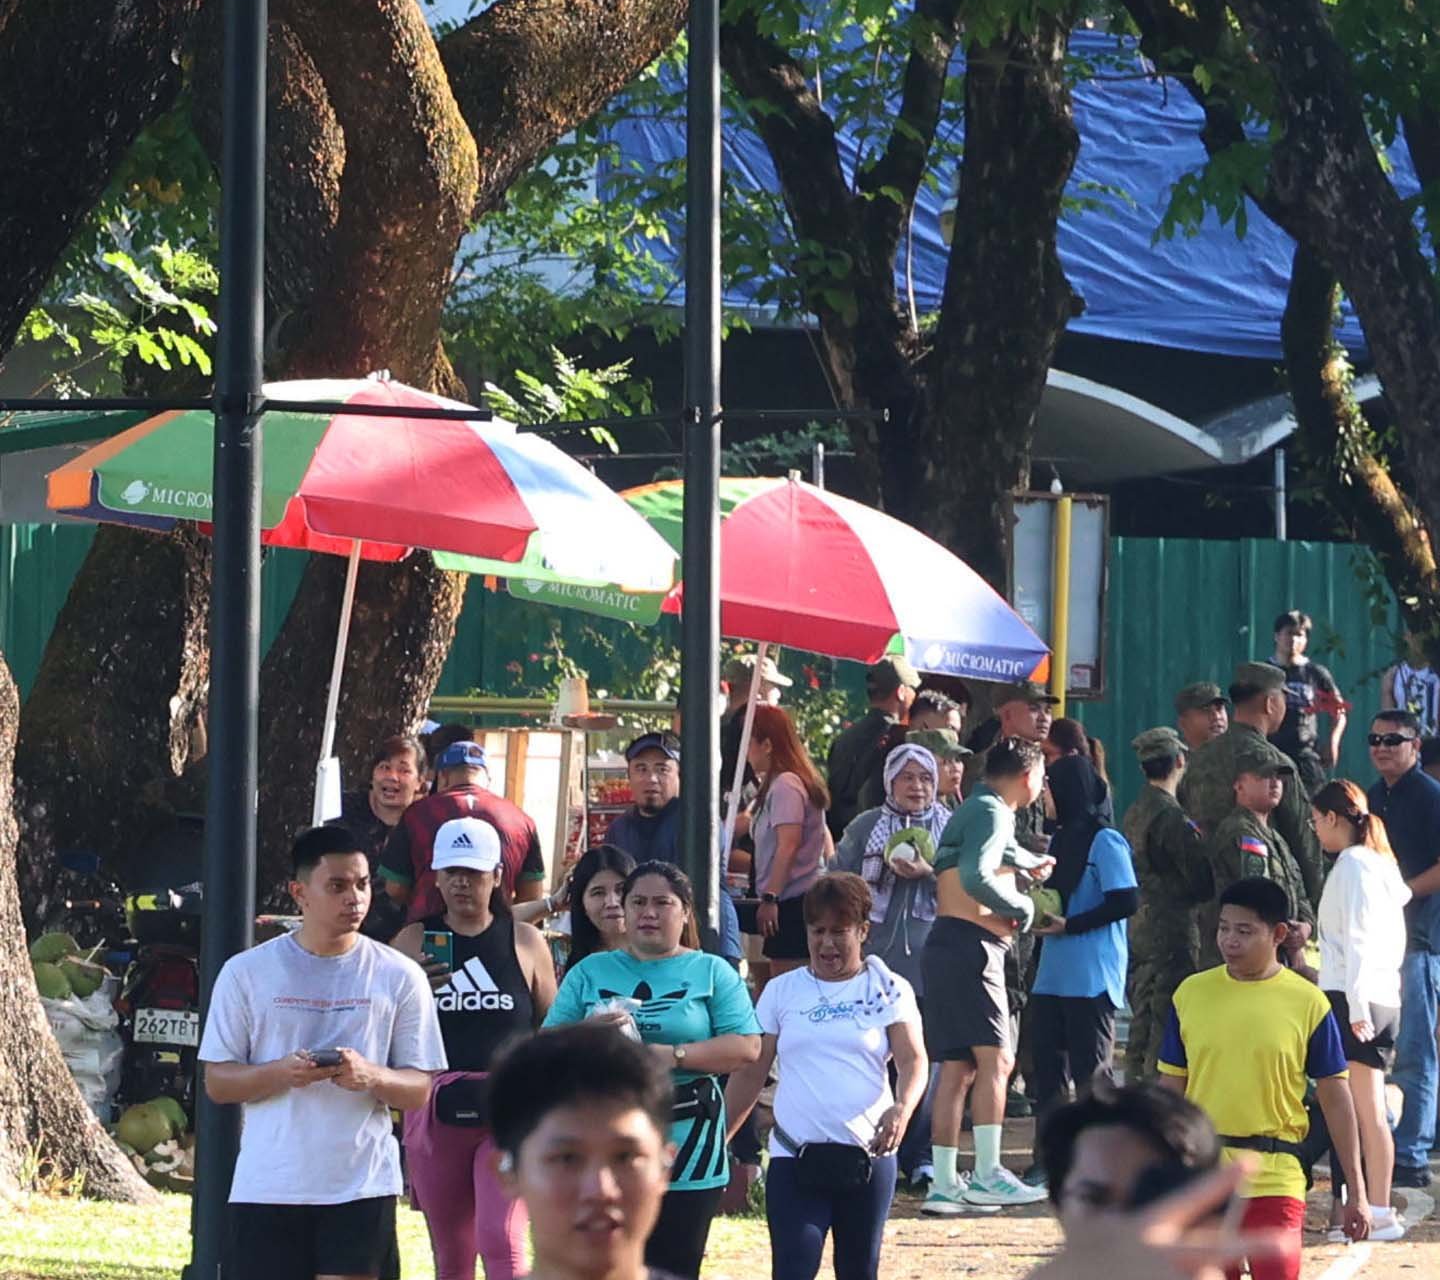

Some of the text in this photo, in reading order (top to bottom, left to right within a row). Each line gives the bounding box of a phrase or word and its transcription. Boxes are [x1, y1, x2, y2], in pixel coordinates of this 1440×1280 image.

[549, 581, 640, 611] MICROMATIC
[945, 651, 1024, 676] MICROMATIC
[138, 1017, 200, 1038] 262TBT
